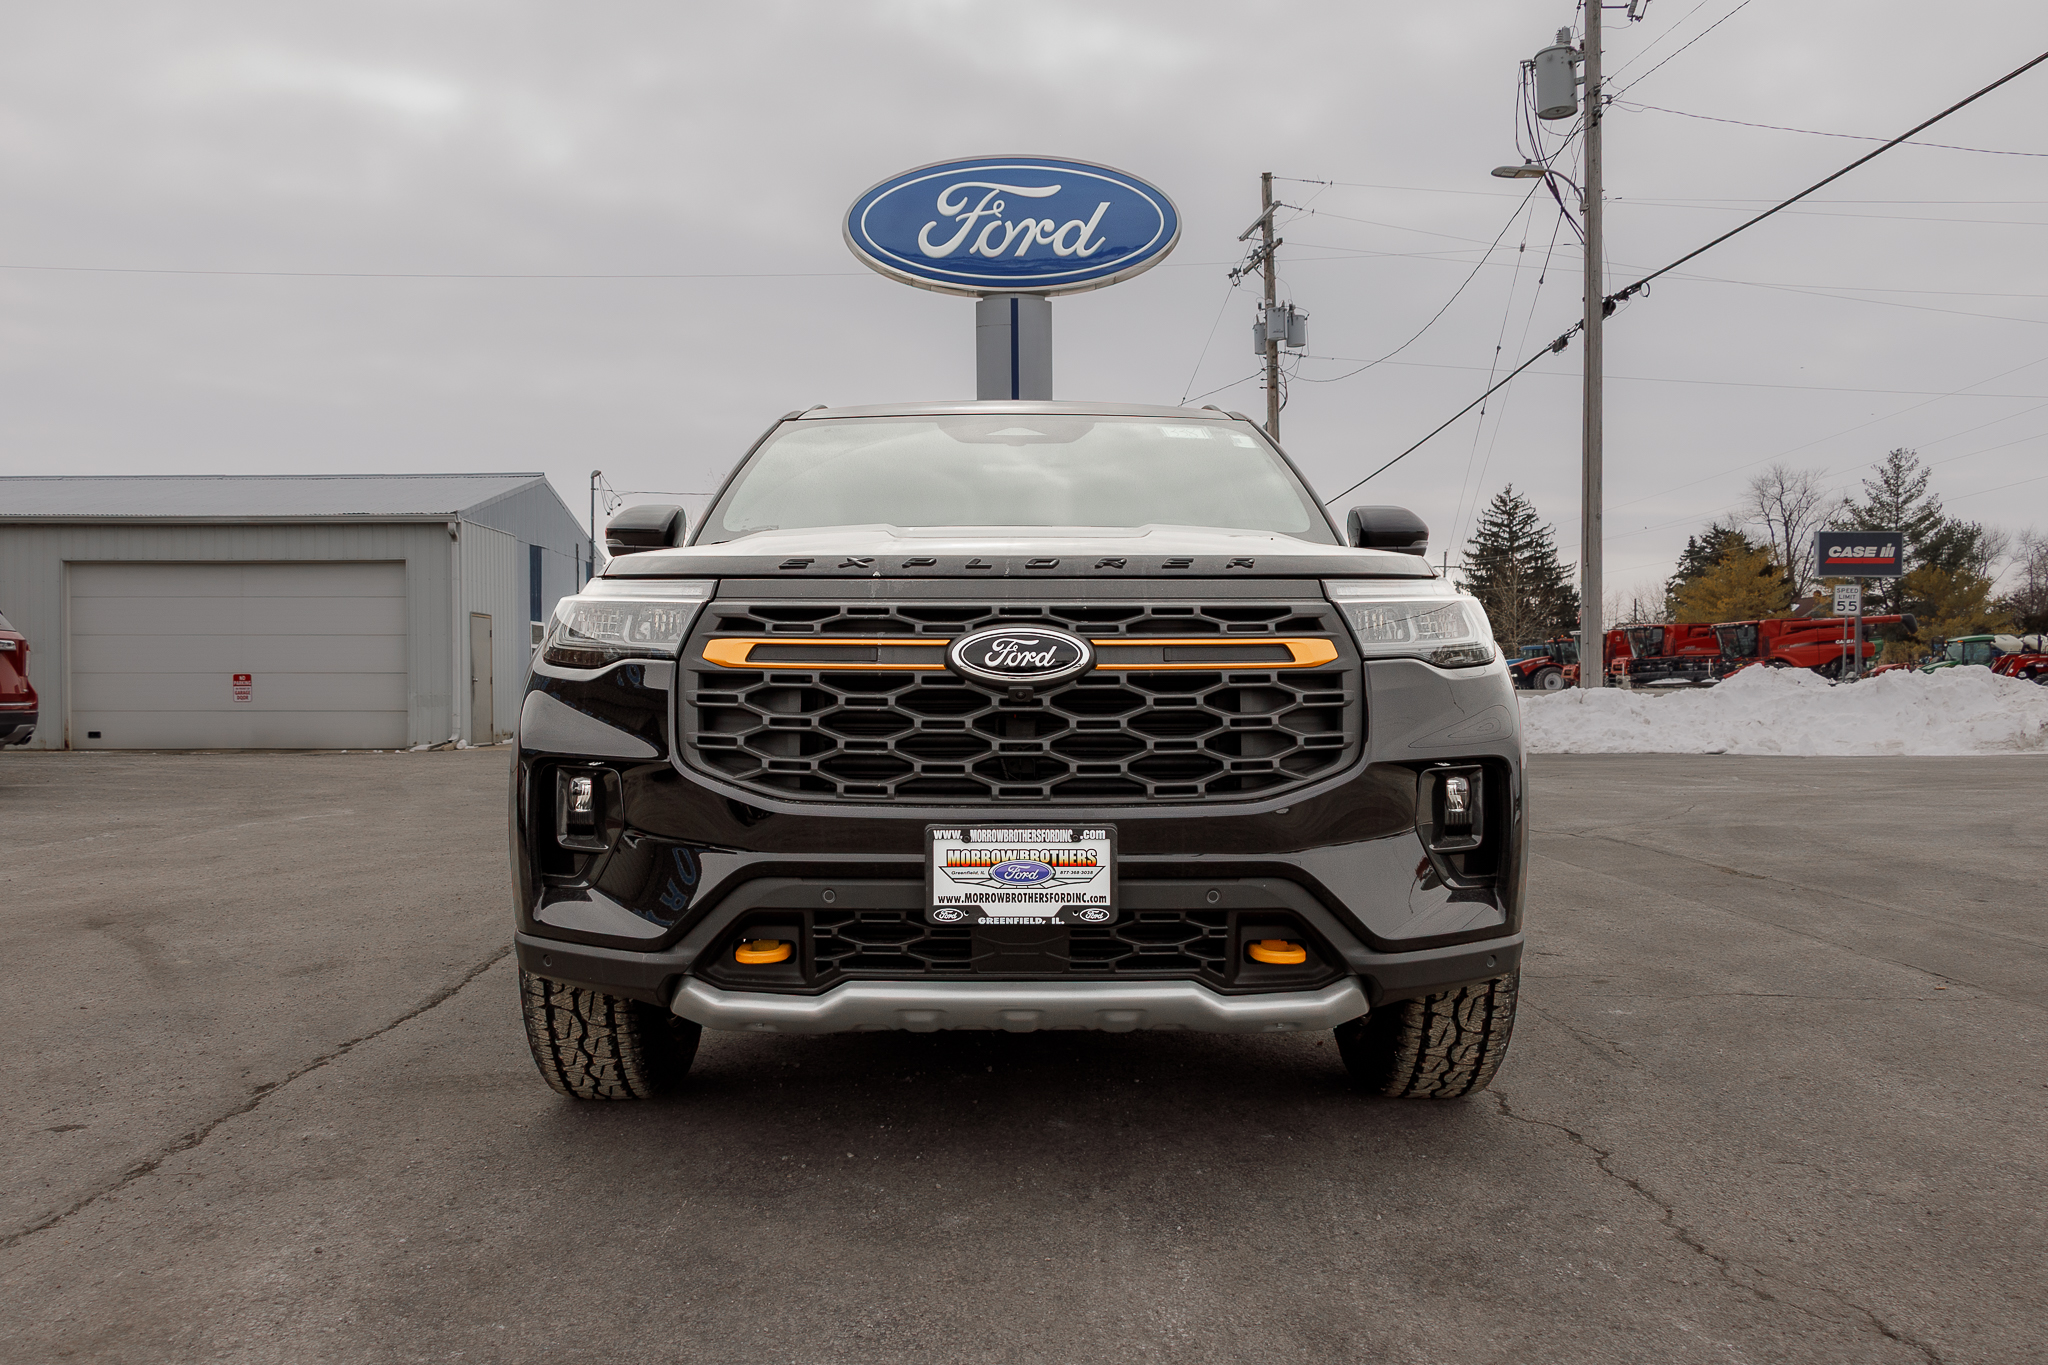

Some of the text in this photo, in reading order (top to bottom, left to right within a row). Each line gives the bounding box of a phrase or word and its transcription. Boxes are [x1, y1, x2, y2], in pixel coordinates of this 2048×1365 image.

[918, 181, 1111, 259] Ford
[1828, 545, 1878, 558] CASE
[778, 556, 1256, 570] EXPLORER
[1836, 600, 1858, 612] 55
[983, 637, 1057, 668] Ford
[1004, 865, 1039, 880] Ford
[938, 892, 1107, 904] www.MORROWBROTHERSFORDINC.com
[938, 910, 959, 920] Ford
[978, 917, 1047, 925] GREENFIELD,
[1085, 910, 1105, 920] Ford
